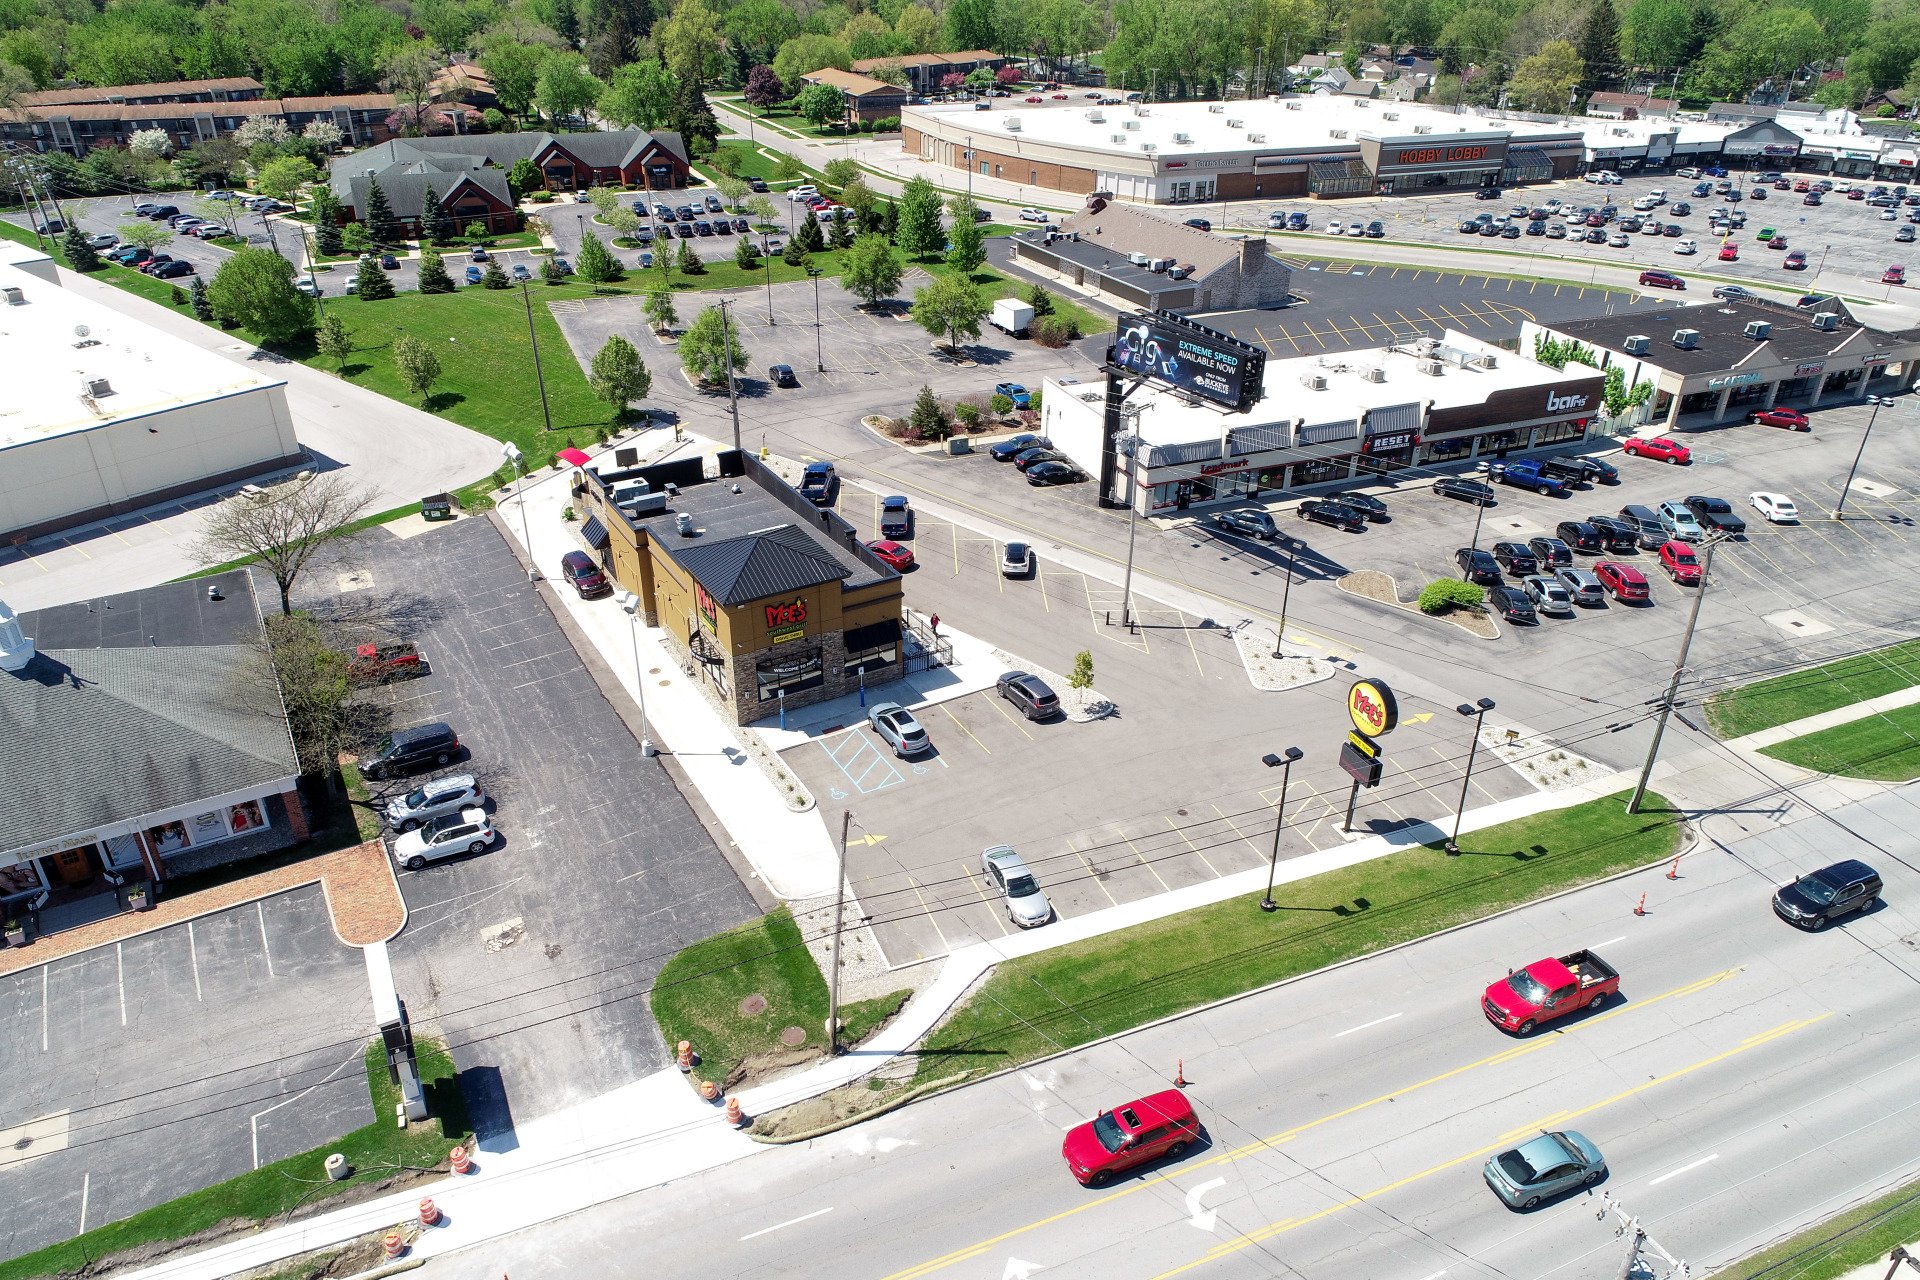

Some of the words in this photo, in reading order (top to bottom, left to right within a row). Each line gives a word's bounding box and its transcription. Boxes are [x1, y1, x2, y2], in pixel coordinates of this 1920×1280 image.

[1399, 149, 1442, 164] HOBBY
[1447, 146, 1488, 161] LOBBY
[1179, 340, 1213, 358] EXTREME
[1214, 351, 1238, 366] SPEED
[1177, 350, 1215, 369] AVAILABLE
[1216, 361, 1237, 375] NOW
[1204, 377, 1230, 391] BUCKEYE
[1374, 434, 1411, 449] RESET
[773, 665, 799, 673] WELCOME
